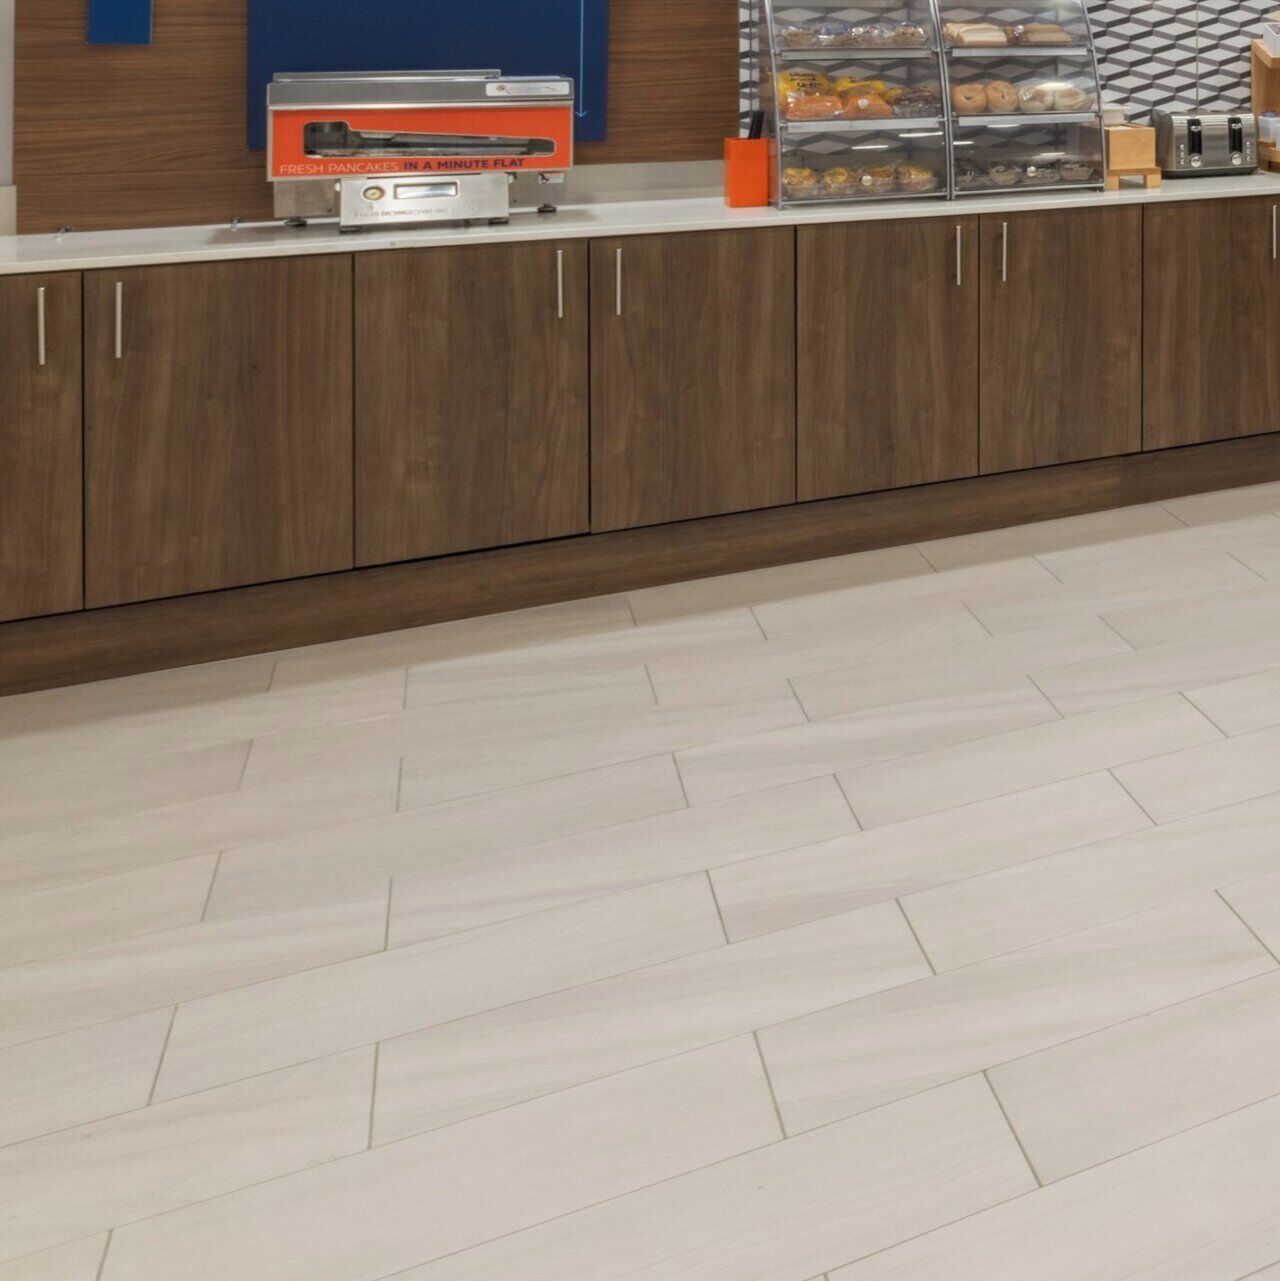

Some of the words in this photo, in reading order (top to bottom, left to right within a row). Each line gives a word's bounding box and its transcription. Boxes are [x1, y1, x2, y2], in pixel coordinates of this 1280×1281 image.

[279, 163, 324, 175] FRESH
[328, 161, 399, 174] PANCAKES
[403, 160, 419, 170] IN
[423, 159, 432, 170] A
[437, 158, 489, 170] MINUTE
[493, 157, 525, 169] FLAT
